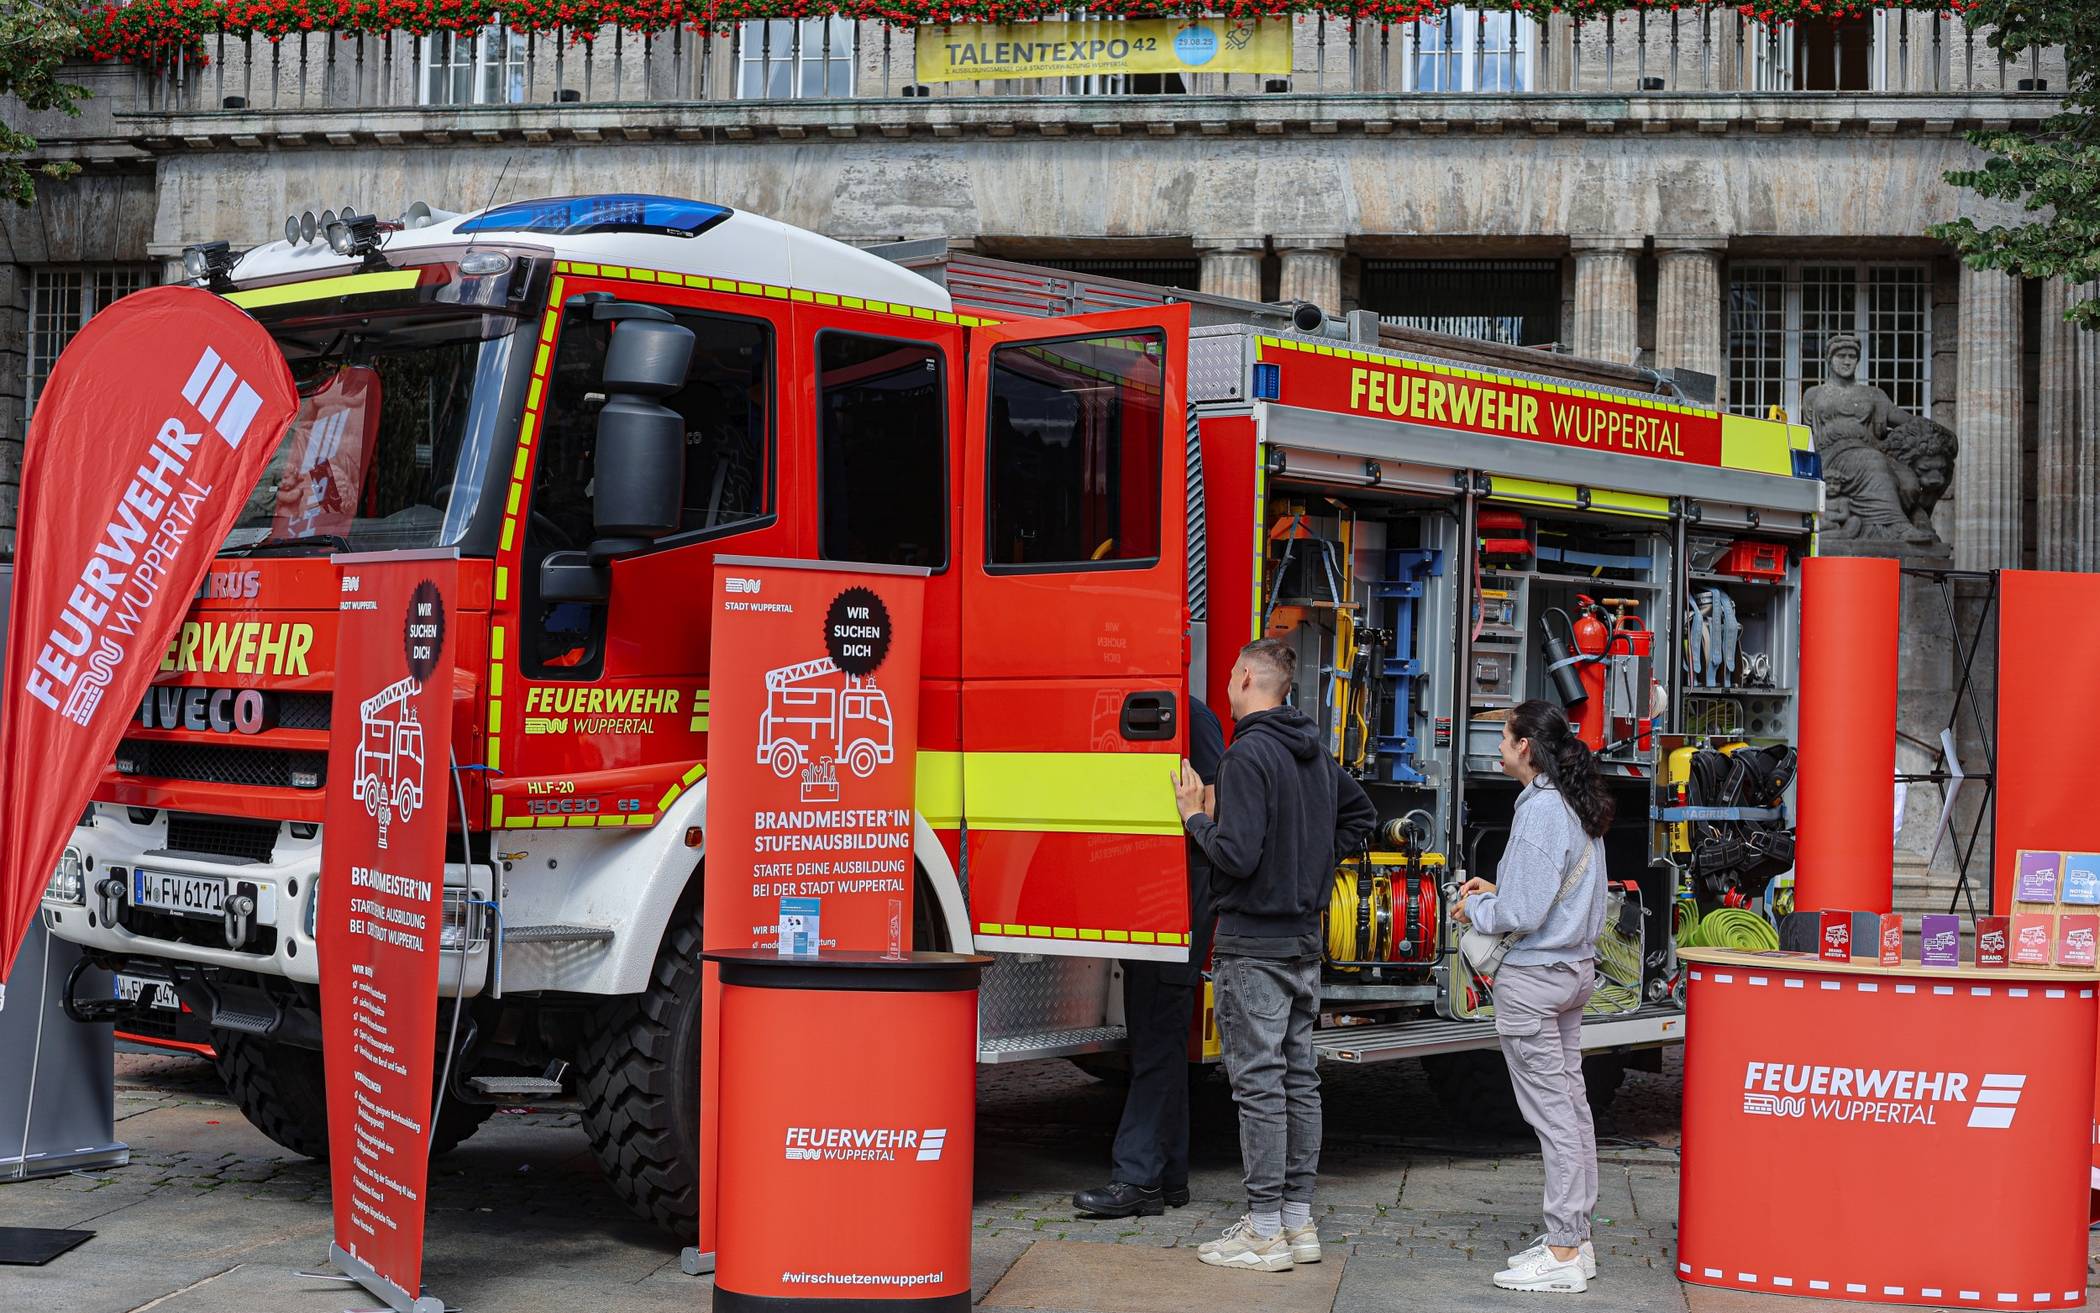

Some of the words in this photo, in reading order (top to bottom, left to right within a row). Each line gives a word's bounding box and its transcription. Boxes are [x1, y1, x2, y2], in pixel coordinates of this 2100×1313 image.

[1178, 38, 1213, 46] 29.08.25
[945, 38, 1129, 66] TALENTEXPO
[1133, 37, 1157, 51] 42
[1350, 367, 1539, 436] FEUERWEHR
[1550, 401, 1684, 457] WUPPERTAL
[25, 416, 203, 712] FEUERWEHR
[107, 477, 213, 637] WUPPERTAL
[193, 570, 261, 599] IRUS
[340, 601, 351, 610] ADT
[418, 603, 431, 616] WIR
[725, 602, 748, 611] STADT
[750, 603, 793, 613] WUPPERTAL
[847, 606, 869, 620] WIR
[410, 624, 437, 638] SUCHEN
[834, 625, 880, 639] SUCHEN
[413, 646, 430, 659] DICH
[843, 645, 871, 657] DICH
[525, 688, 680, 714] FEUERWEHR
[142, 686, 264, 735] IVECO
[573, 718, 654, 734] WUPPERTAL
[527, 781, 575, 794] HLF-20
[527, 799, 600, 814] 150E30
[618, 799, 640, 811] E5
[1682, 809, 1729, 818] MAGIRUS
[754, 833, 909, 852] STUFENAUSBILDUNG
[753, 863, 792, 878] STARTE
[796, 862, 830, 876] DEINE
[832, 860, 905, 874] AUSBILDUNG
[144, 875, 152, 901] W
[162, 878, 181, 905] FW
[184, 880, 222, 911] 6171
[753, 884, 769, 897] BEI
[773, 883, 796, 896] DER
[800, 881, 834, 895] STADT
[838, 879, 904, 893] WUPPERTAL
[386, 907, 425, 930] AUSBILDUNG
[350, 919, 364, 934] BEI
[388, 930, 424, 952] WUPPERTAL
[752, 926, 768, 935] WIR
[820, 938, 836, 947] tung
[1744, 1061, 1969, 1102] FEUERWEHR
[1810, 1098, 1936, 1125] WUPPERTAL
[785, 1127, 918, 1148] FEUERWEHR
[824, 1149, 895, 1161] WUPPERTAL
[782, 1271, 943, 1287] #wirschuetzenwuppertal
